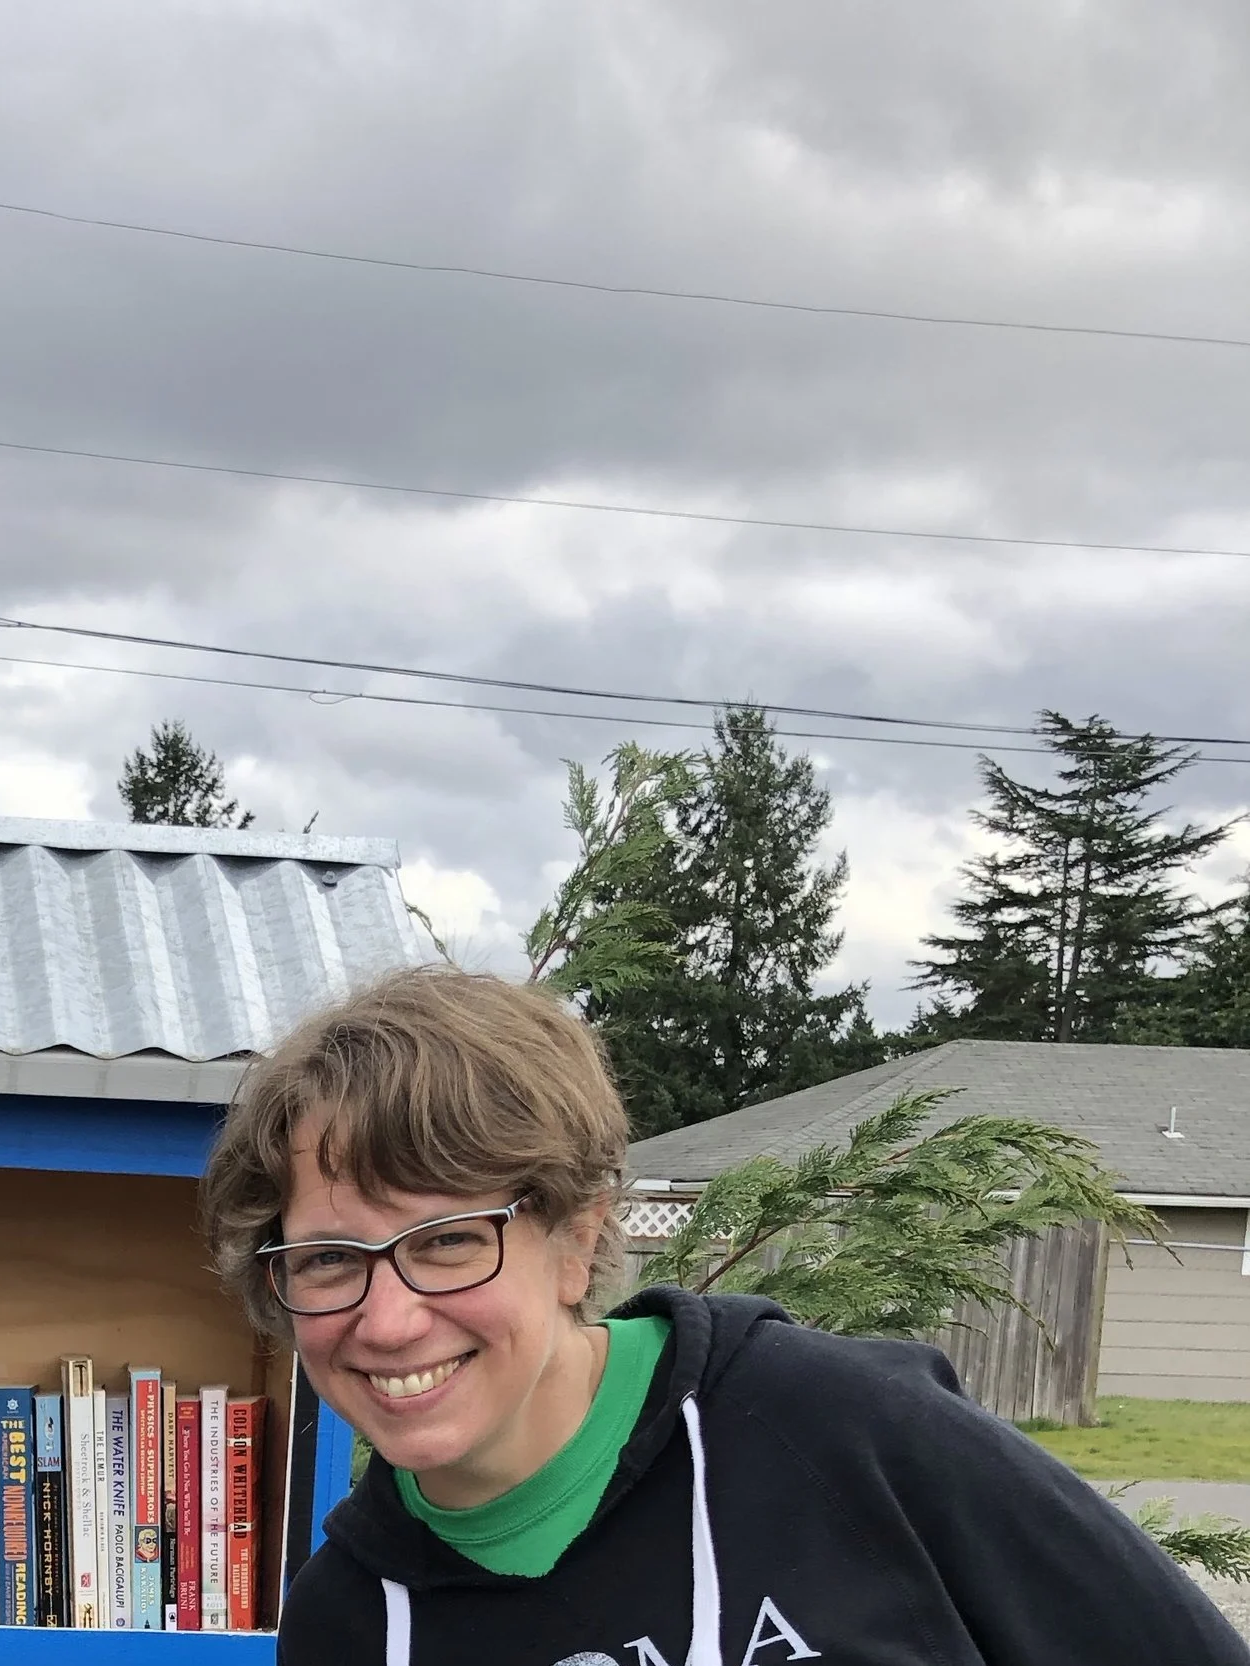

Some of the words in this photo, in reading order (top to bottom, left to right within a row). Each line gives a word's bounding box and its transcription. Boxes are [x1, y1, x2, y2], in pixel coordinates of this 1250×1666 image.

[0, 1420, 25, 1429] THE
[112, 1410, 123, 1432] THE
[233, 1409, 247, 1457] COLSON
[96, 1431, 104, 1447] THE
[113, 1436, 124, 1476] WATER
[9, 1432, 26, 1483] BEST
[38, 1456, 60, 1467] SLAM
[81, 1433, 90, 1483] Sheetrock
[184, 1462, 190, 1472] Go
[43, 1482, 51, 1521] NICK
[82, 1488, 91, 1496] &
[113, 1481, 124, 1516] KNIFE
[211, 1498, 218, 1512] OF
[234, 1464, 247, 1539] WHITEHEAD
[3, 1486, 27, 1560] NONREQUIRED
[82, 1501, 92, 1538] Shellac
[184, 1528, 190, 1536] Be
[115, 1524, 124, 1554] PAOLO
[44, 1529, 53, 1596] HORNBY
[16, 1563, 26, 1624] READING
[115, 1556, 125, 1608] BACIGALUPI
[180, 1582, 188, 1609] BRUNI
[188, 1580, 196, 1611] FRANK
